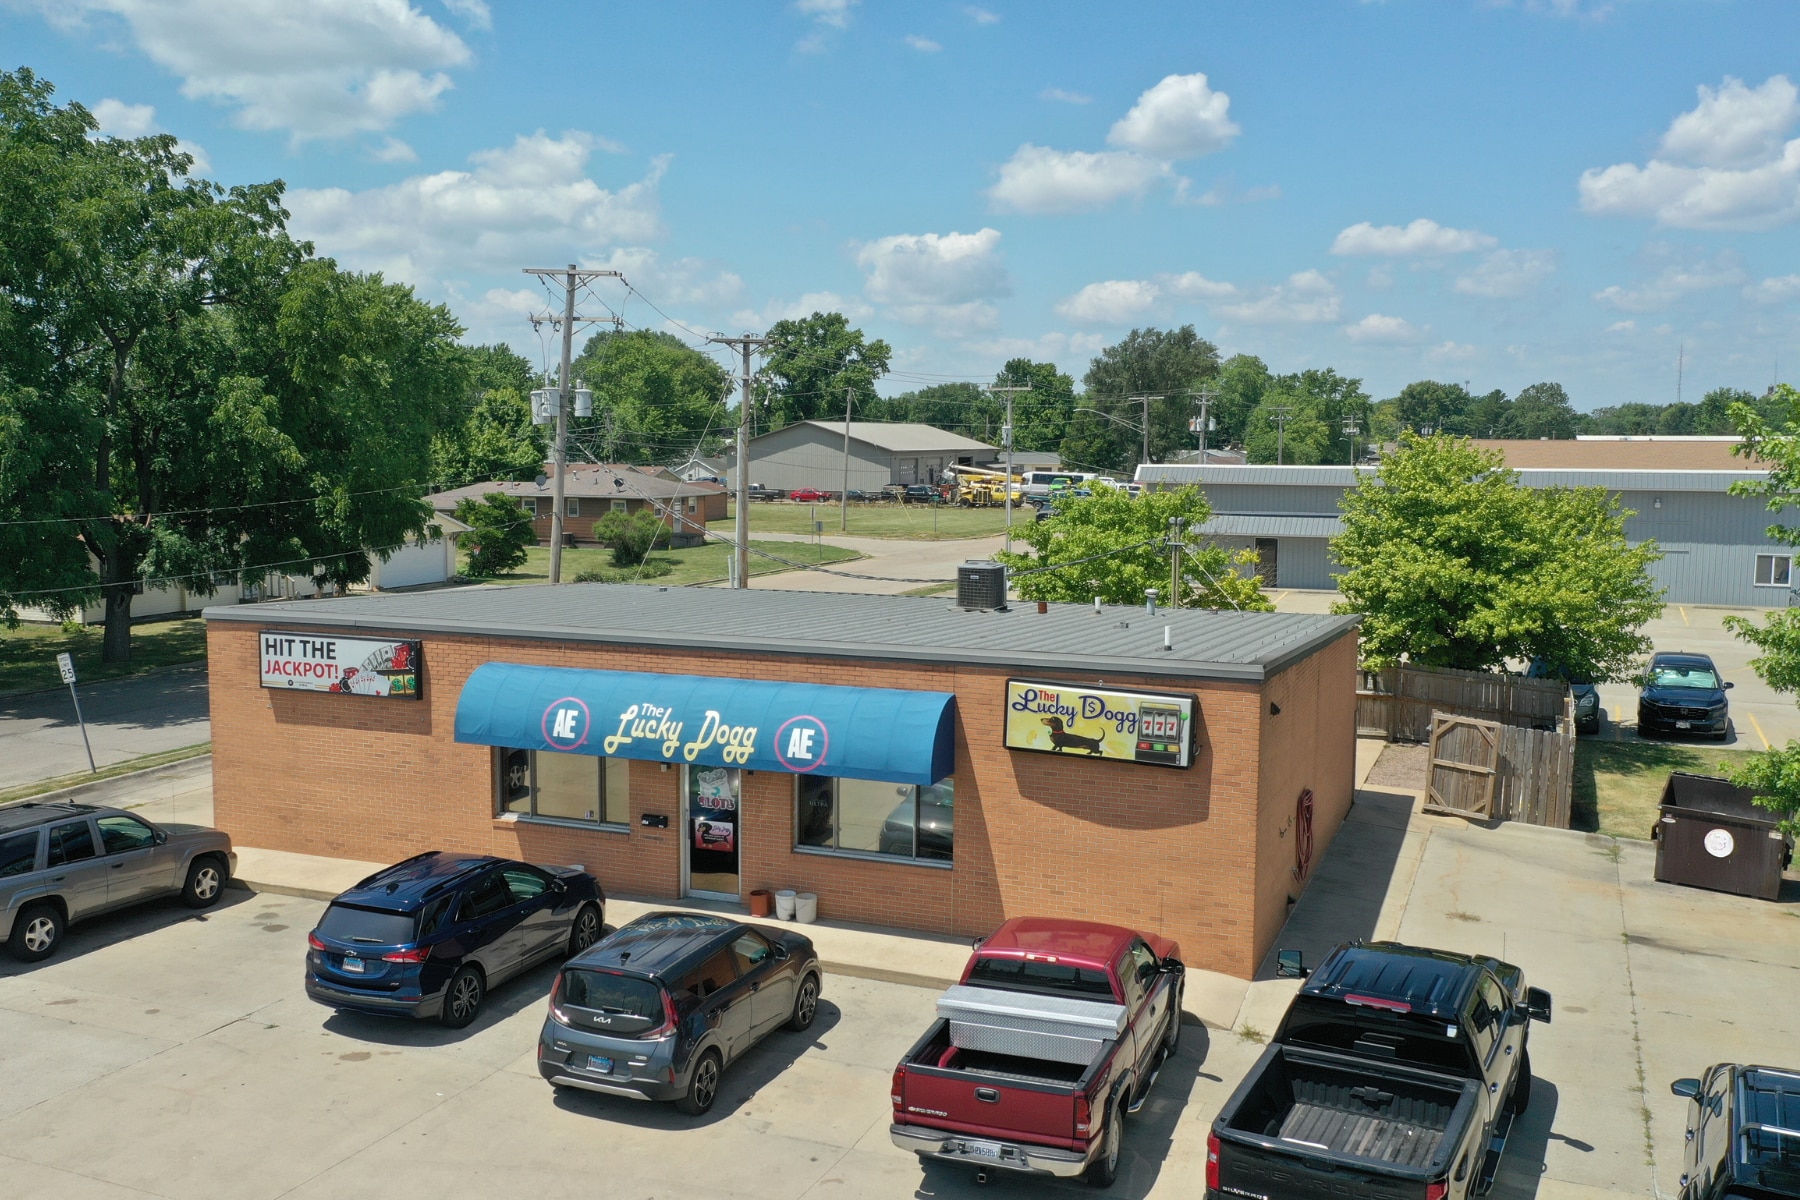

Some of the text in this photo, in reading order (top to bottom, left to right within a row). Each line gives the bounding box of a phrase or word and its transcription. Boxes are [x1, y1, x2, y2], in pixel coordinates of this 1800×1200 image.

[265, 637, 337, 660] HIT THE
[61, 668, 74, 680] 25
[264, 659, 339, 680] JACKPOT!
[1038, 689, 1056, 703] The
[641, 703, 665, 718] The
[1011, 688, 1139, 734] Lucky Dogg
[553, 708, 579, 739] AE
[603, 704, 757, 764] Lucky Dogg
[787, 728, 816, 760] AE
[698, 795, 735, 810] SLOTS
